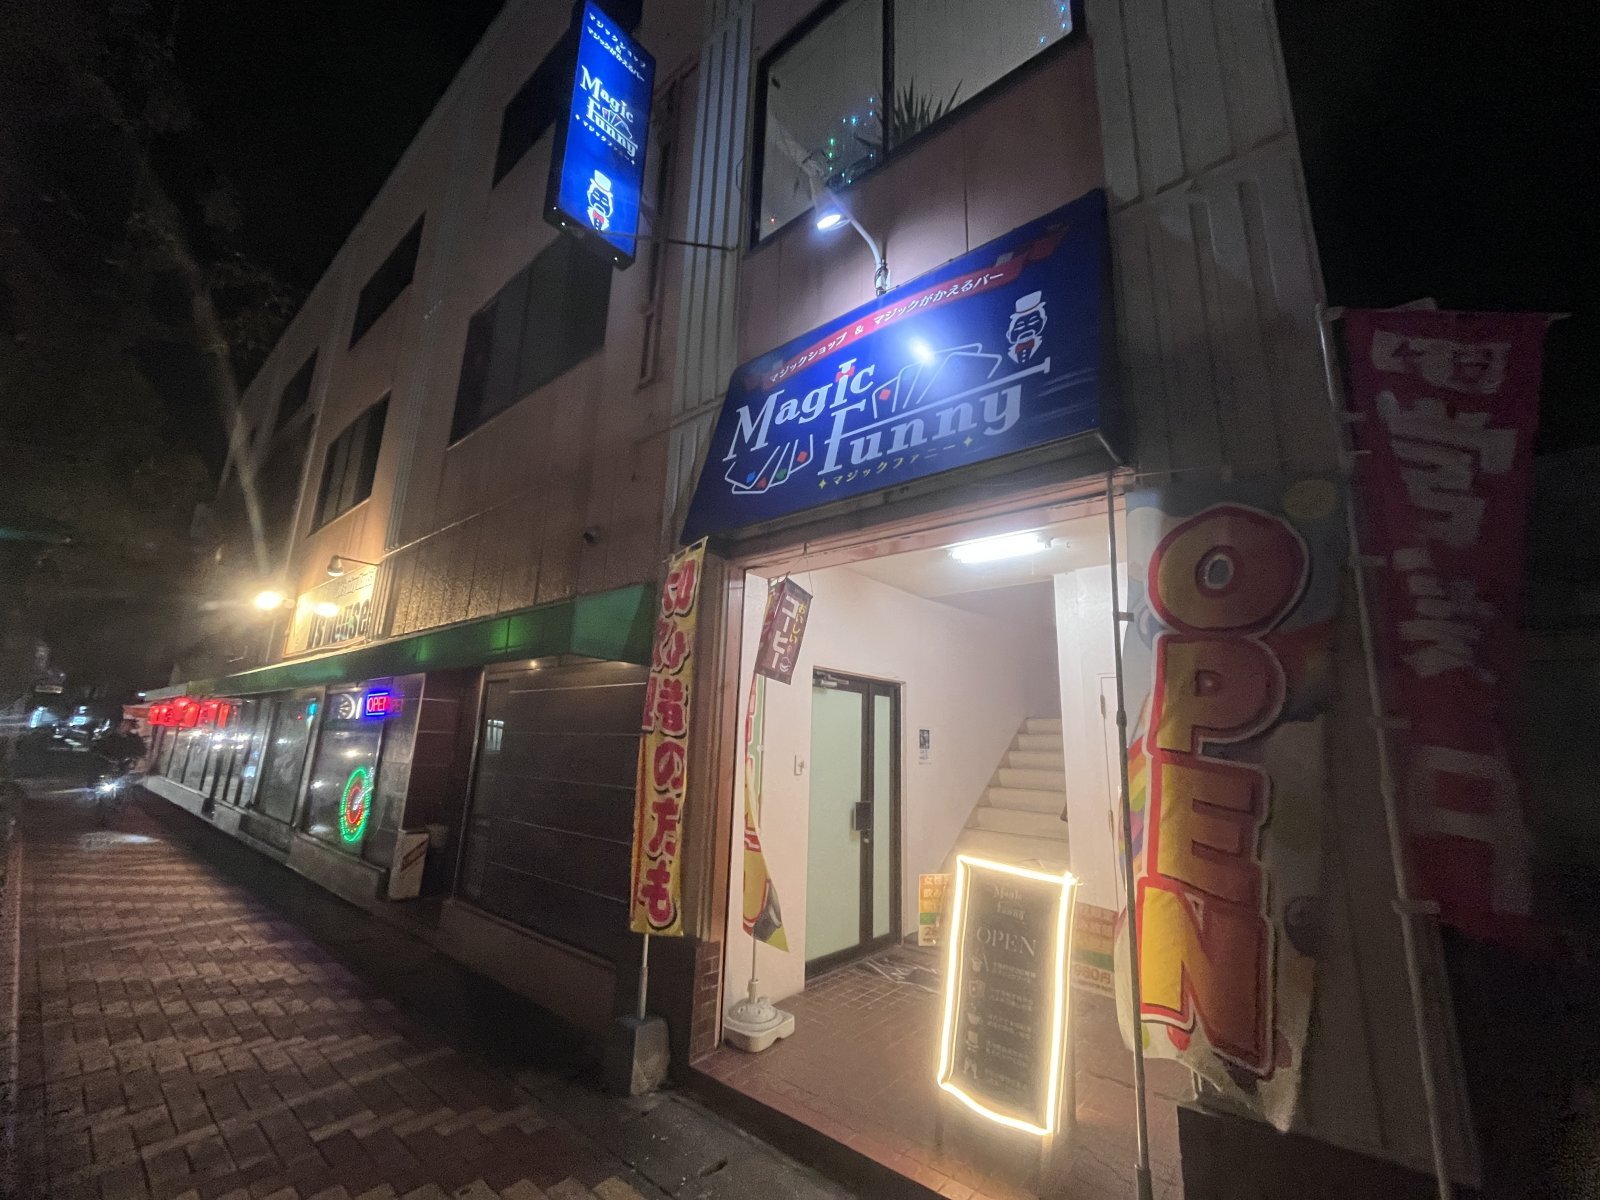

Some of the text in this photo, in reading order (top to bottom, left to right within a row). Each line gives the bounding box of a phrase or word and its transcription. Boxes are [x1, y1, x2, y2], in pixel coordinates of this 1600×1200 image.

[580, 64, 634, 123] Magic
[586, 96, 639, 157] Funny
[769, 272, 1004, 383] マジックショップ & マジックがかえるバー
[722, 358, 875, 462] Magic
[817, 357, 1051, 476] Funny
[833, 444, 956, 486] マジックファニー
[771, 594, 800, 669] コーヒー
[1136, 503, 1310, 1080] OPEN
[976, 926, 1036, 957] OPEN
